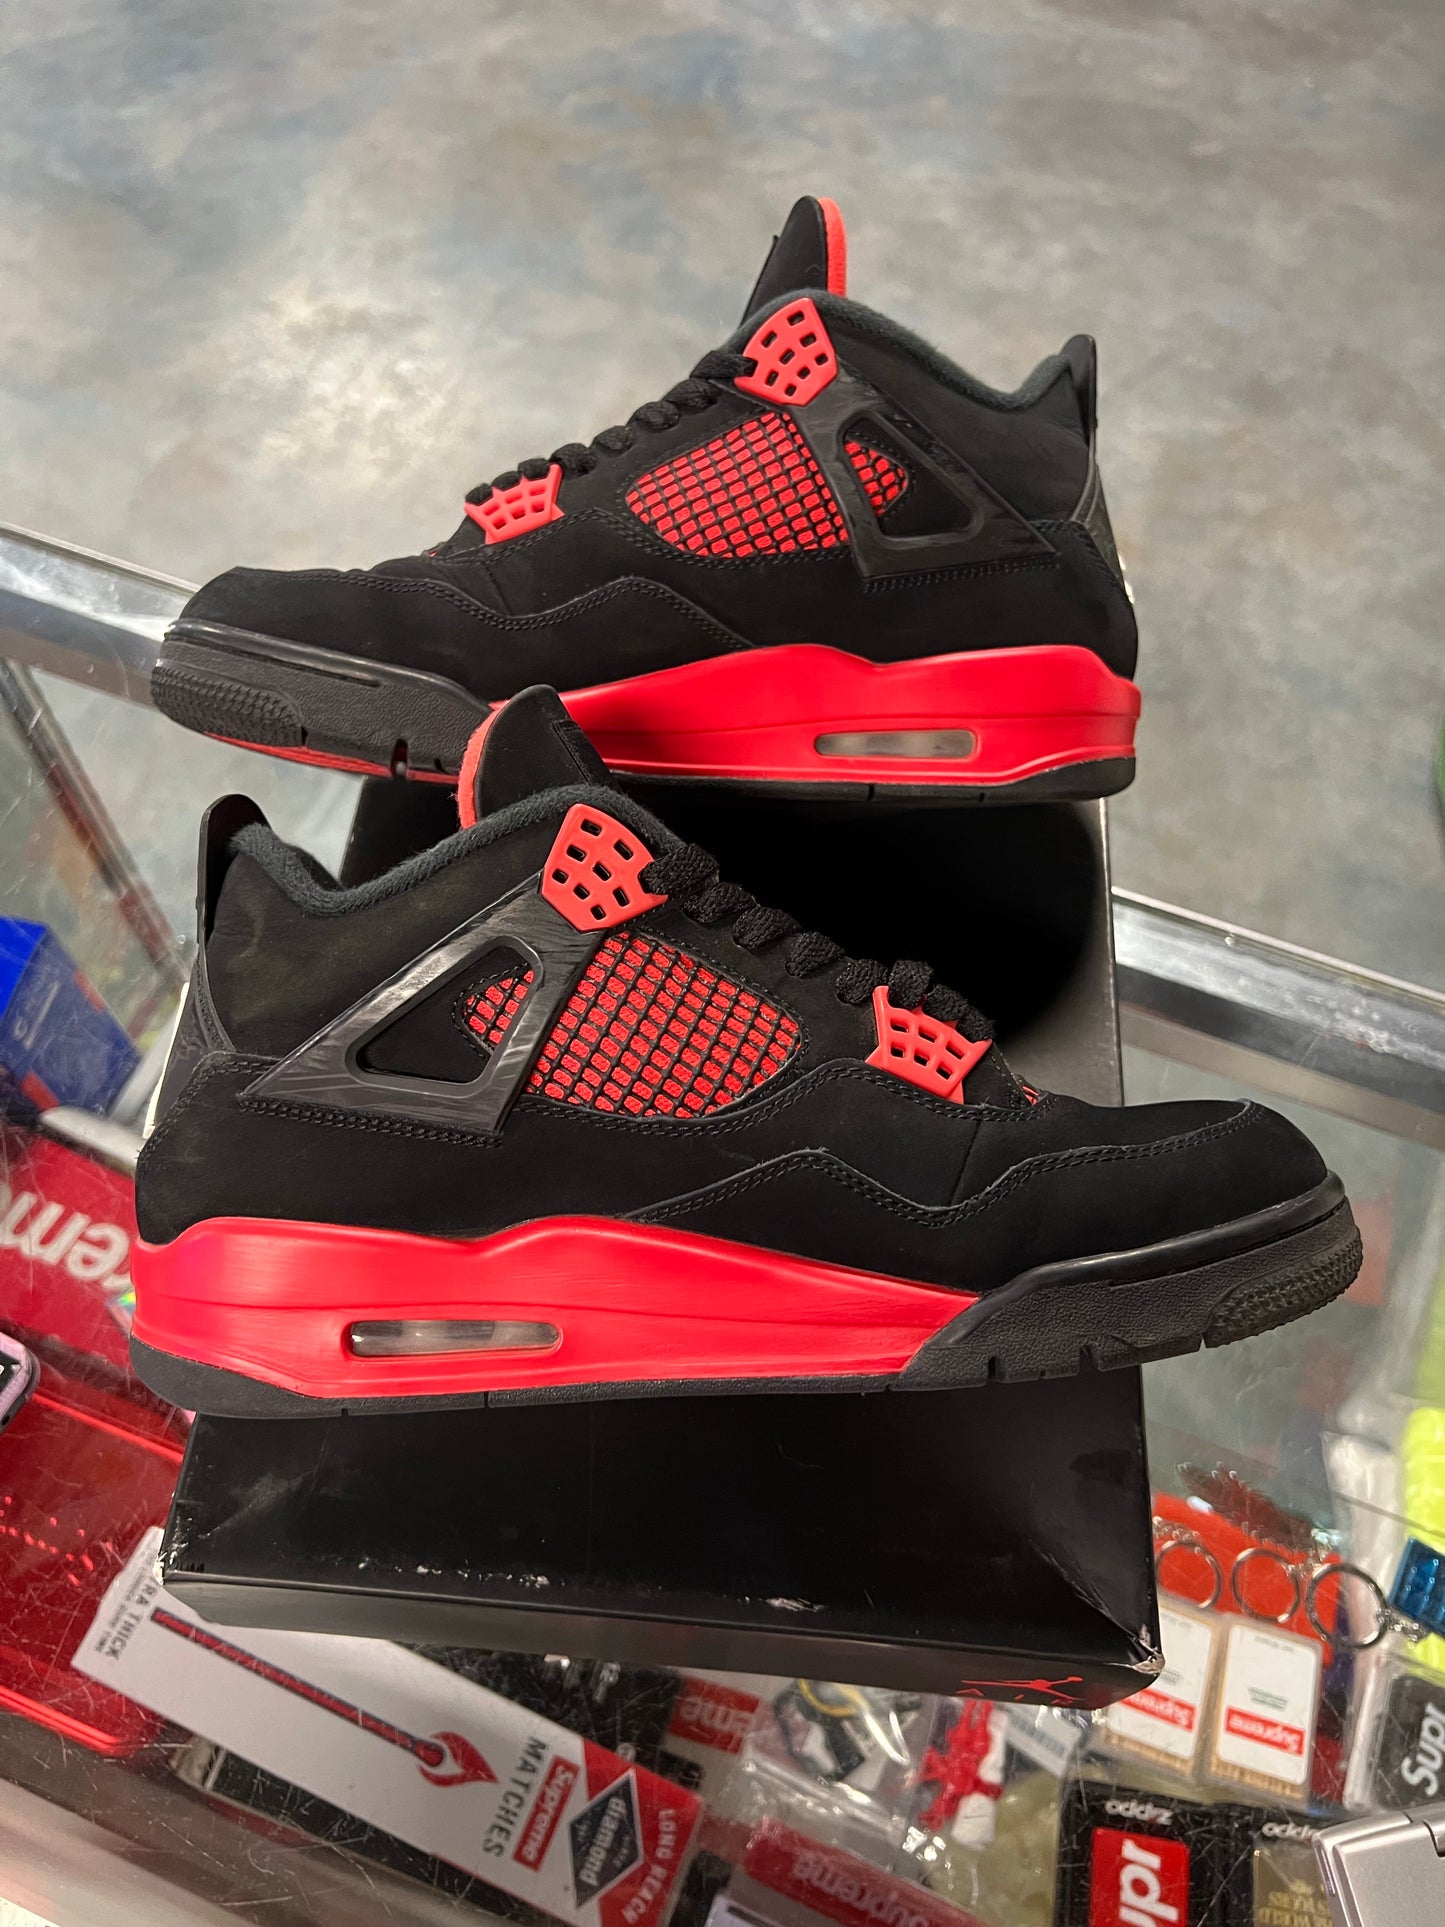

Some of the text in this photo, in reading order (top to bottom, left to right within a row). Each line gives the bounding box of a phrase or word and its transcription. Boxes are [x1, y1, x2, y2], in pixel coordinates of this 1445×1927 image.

[105, 1612, 142, 1660] THICK
[1230, 1714, 1300, 1750] Supreme
[482, 1736, 548, 1857] MATCHES
[521, 1764, 574, 1863] Supreme
[579, 1797, 627, 1886] diamond
[655, 1808, 676, 1860] LONG
[622, 1864, 668, 1926] REACH
